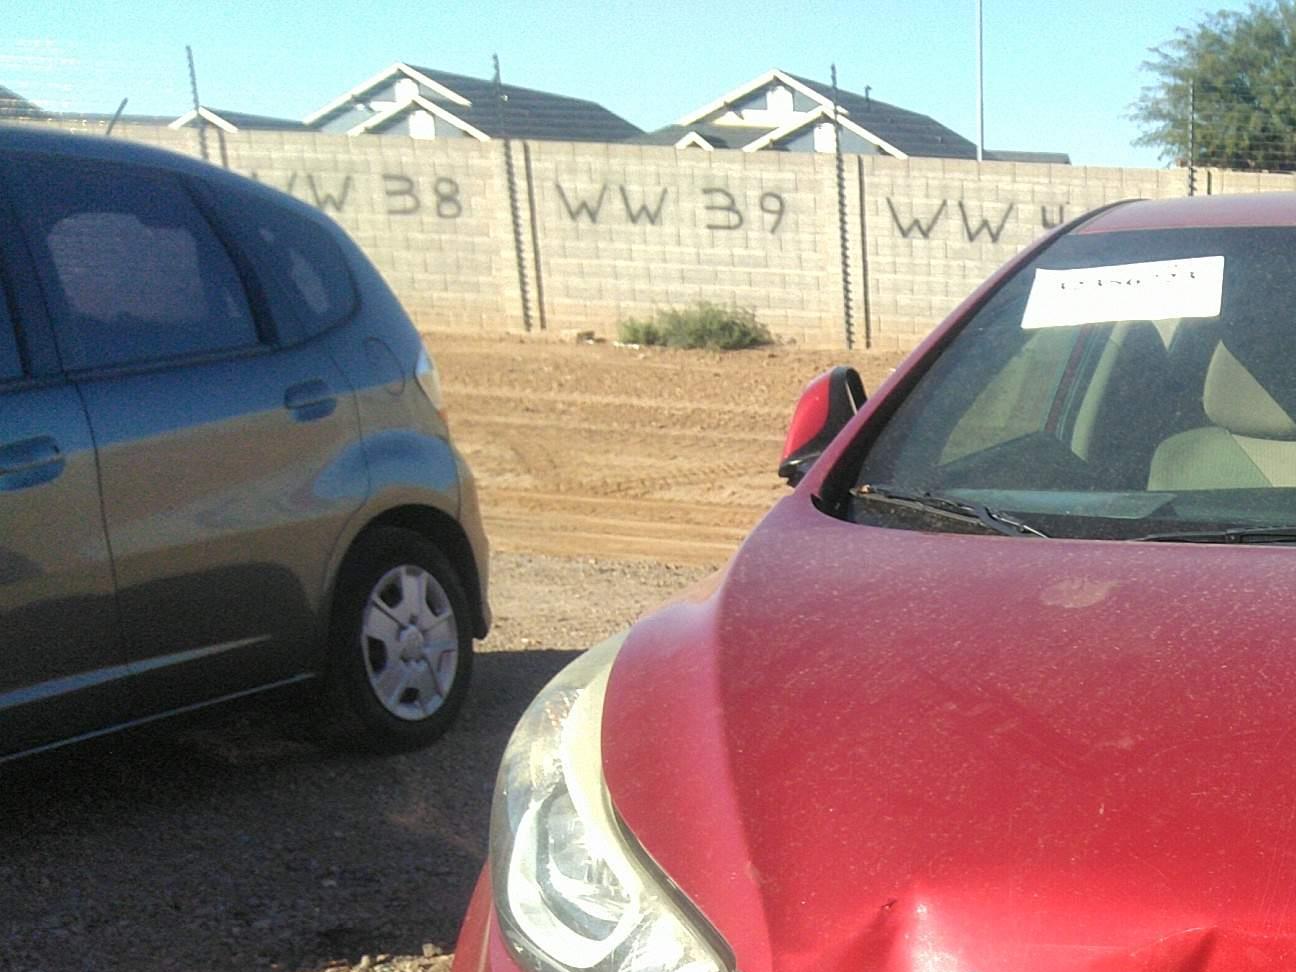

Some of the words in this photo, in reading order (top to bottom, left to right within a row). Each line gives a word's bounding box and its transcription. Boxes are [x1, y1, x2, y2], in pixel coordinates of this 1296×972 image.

[382, 173, 462, 219] 38
[555, 183, 668, 225] WW
[702, 188, 784, 234] 39
[886, 197, 1013, 243] WW
